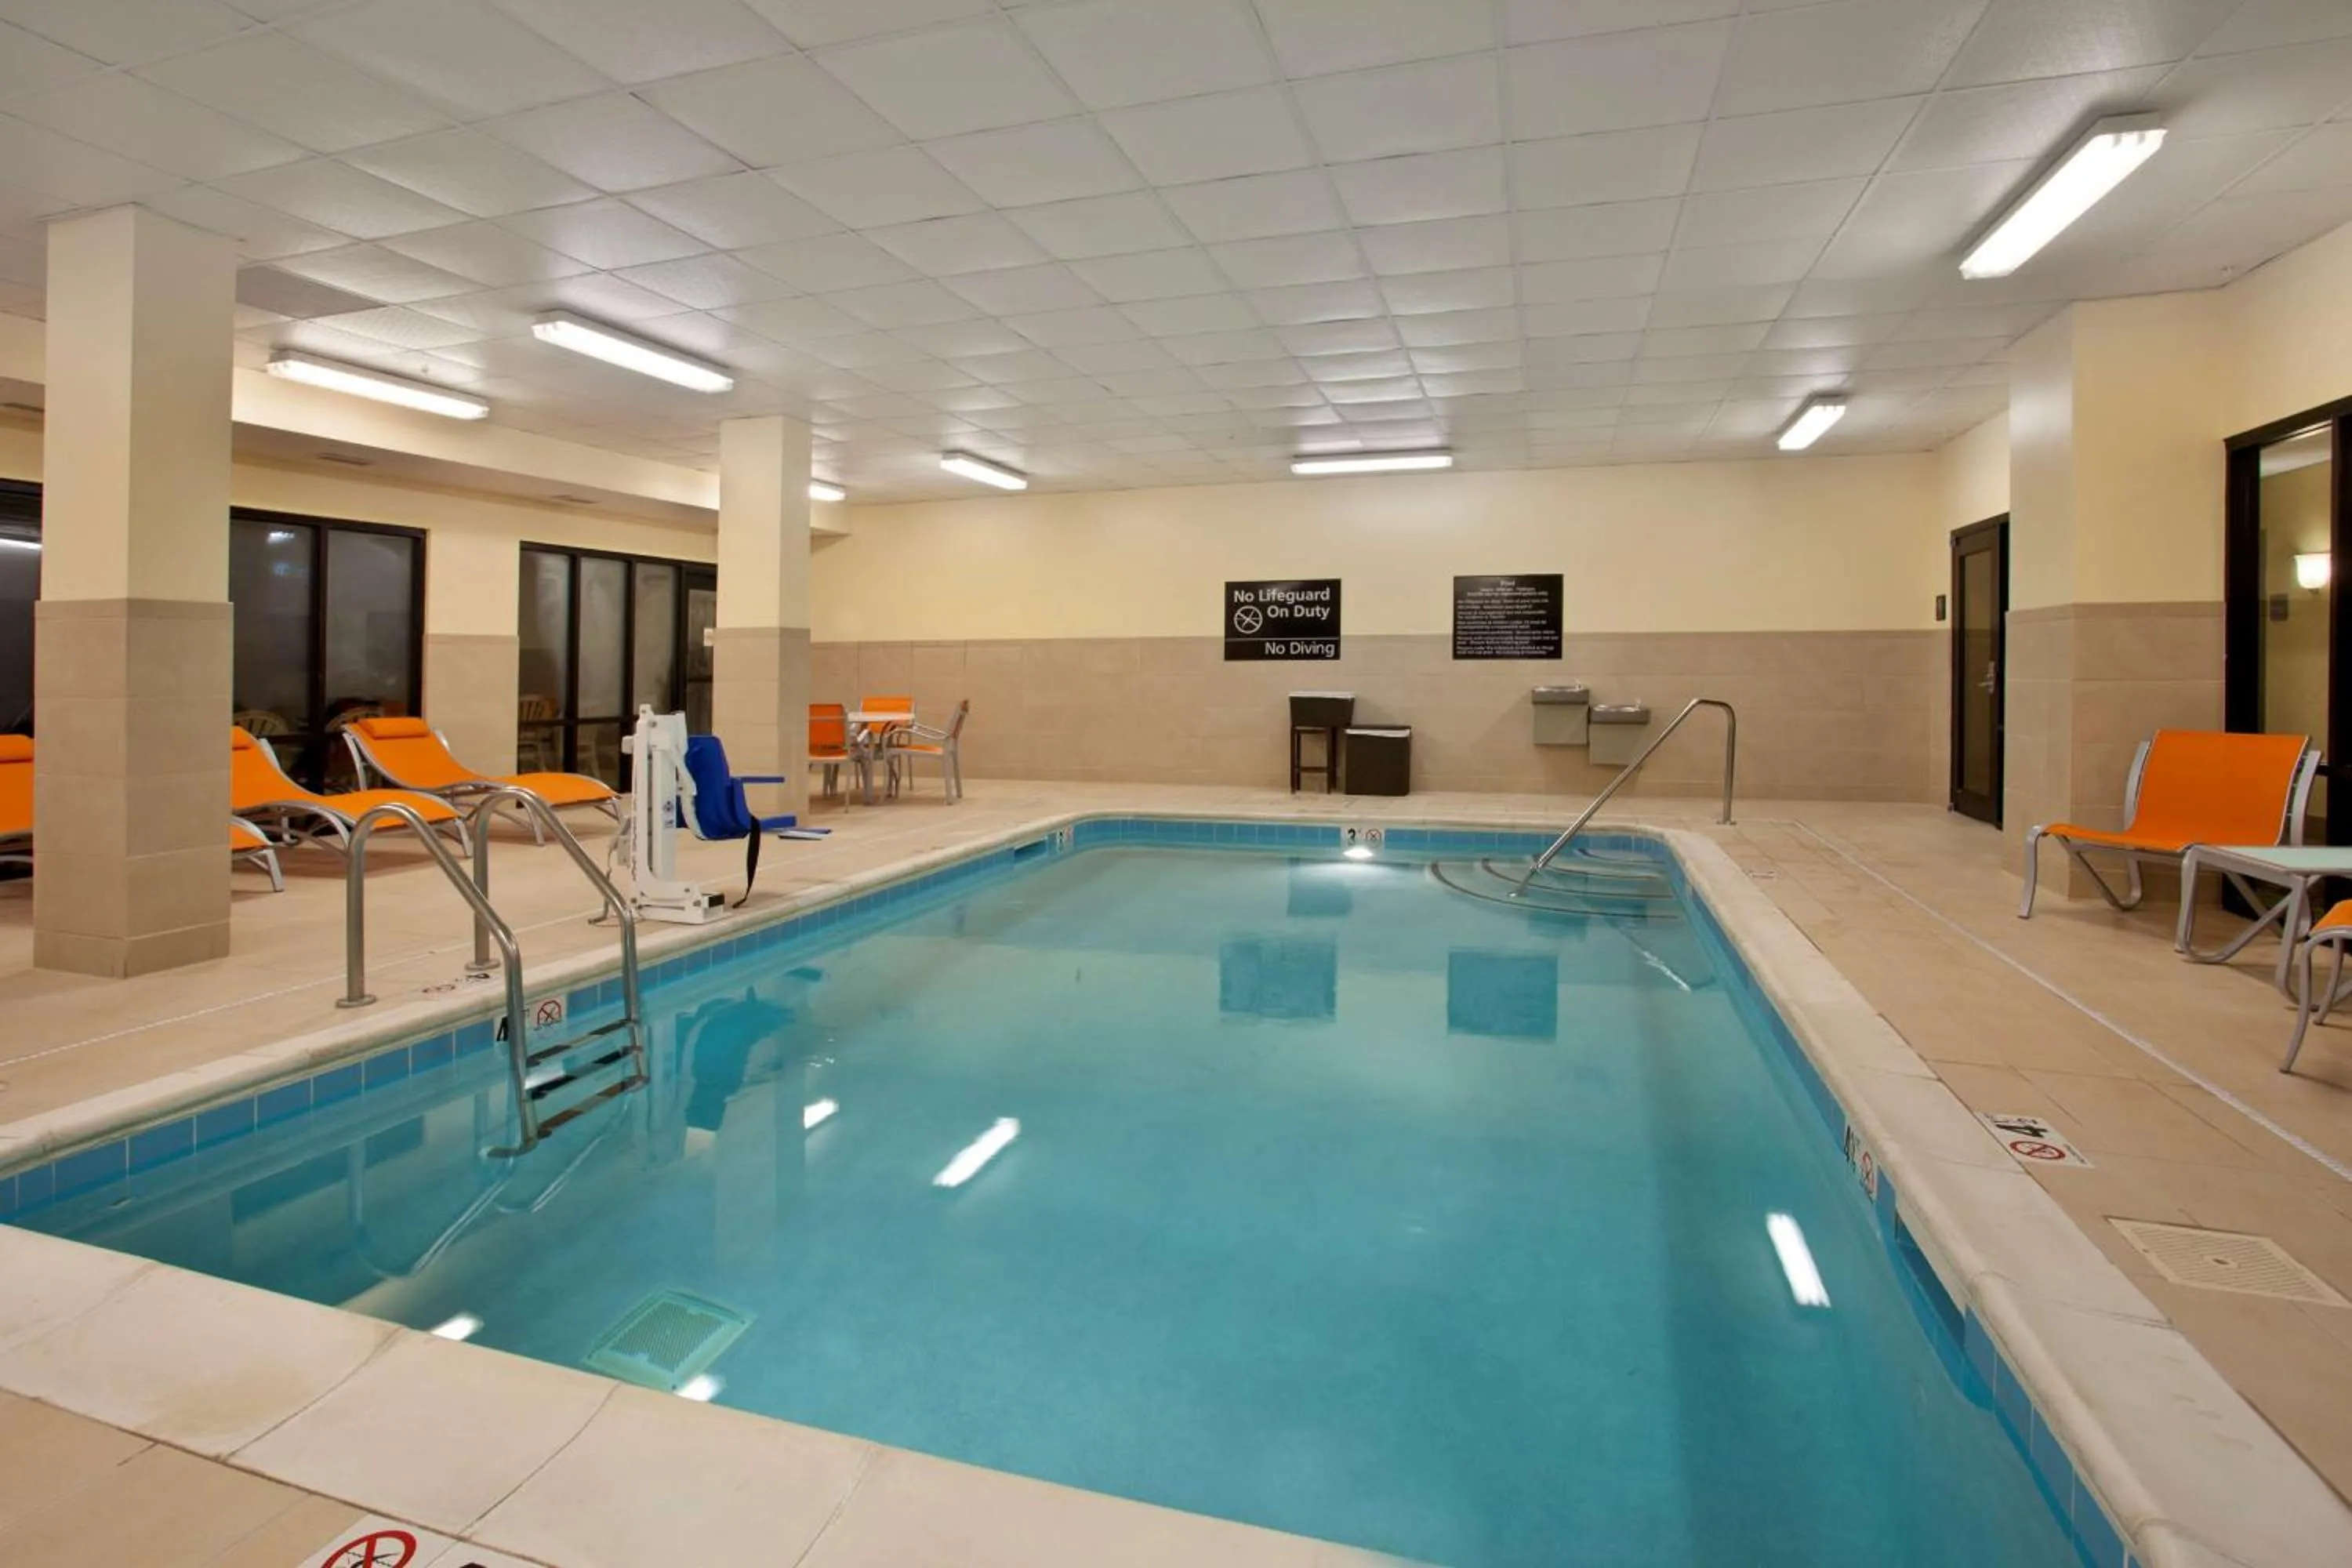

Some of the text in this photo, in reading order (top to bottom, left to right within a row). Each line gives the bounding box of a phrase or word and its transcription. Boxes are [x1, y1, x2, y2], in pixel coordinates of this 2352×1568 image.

[1233, 587, 1330, 604] No Lifeguard
[1267, 604, 1330, 620] On Duty
[1265, 641, 1335, 657] No Diving
